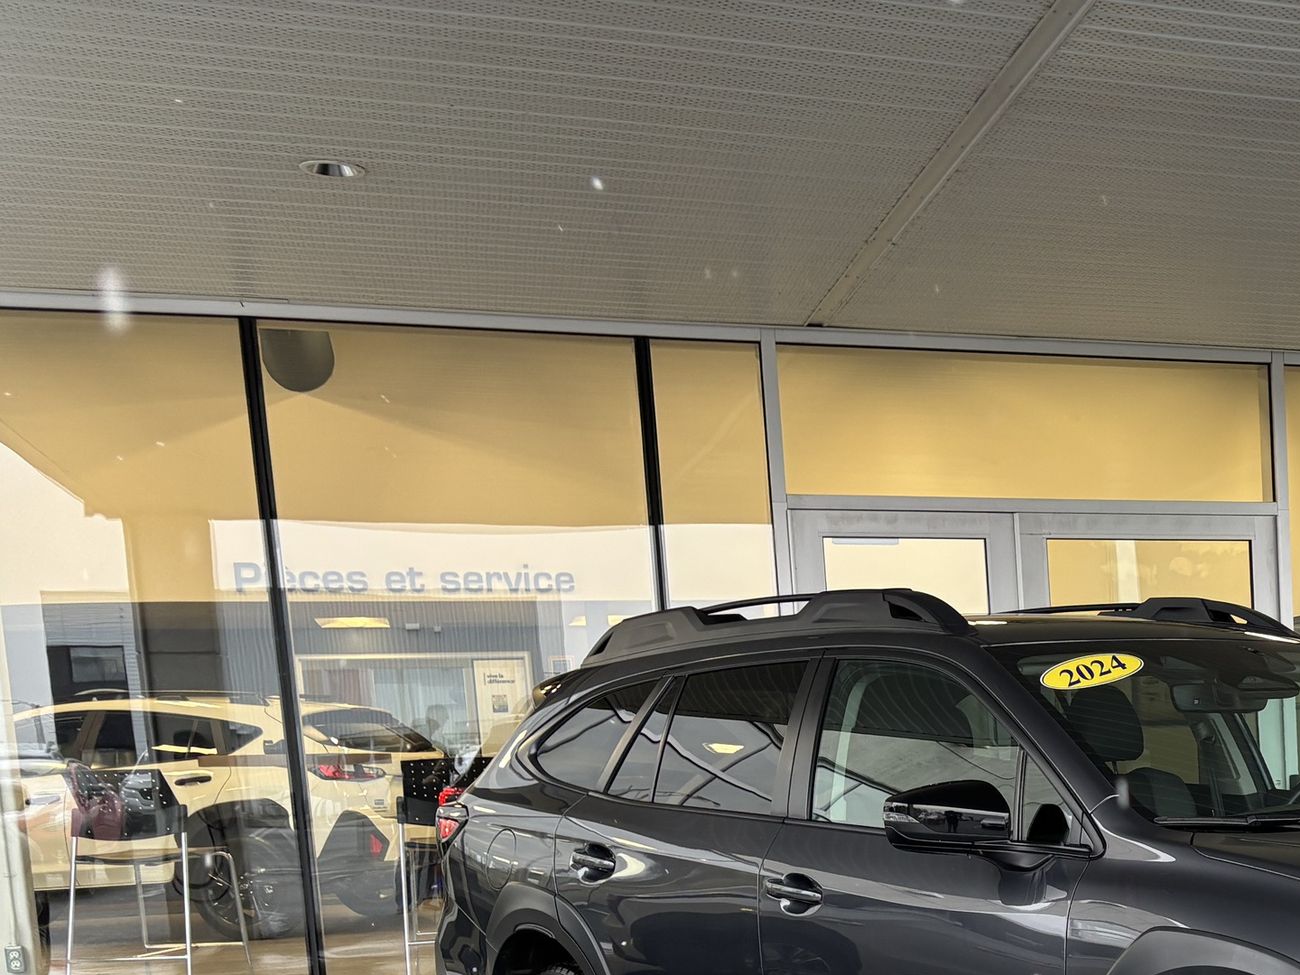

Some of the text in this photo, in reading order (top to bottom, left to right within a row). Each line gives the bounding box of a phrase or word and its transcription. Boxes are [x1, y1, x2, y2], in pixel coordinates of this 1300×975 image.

[233, 562, 575, 593] Pèces et service
[1060, 655, 1127, 687] 2024
